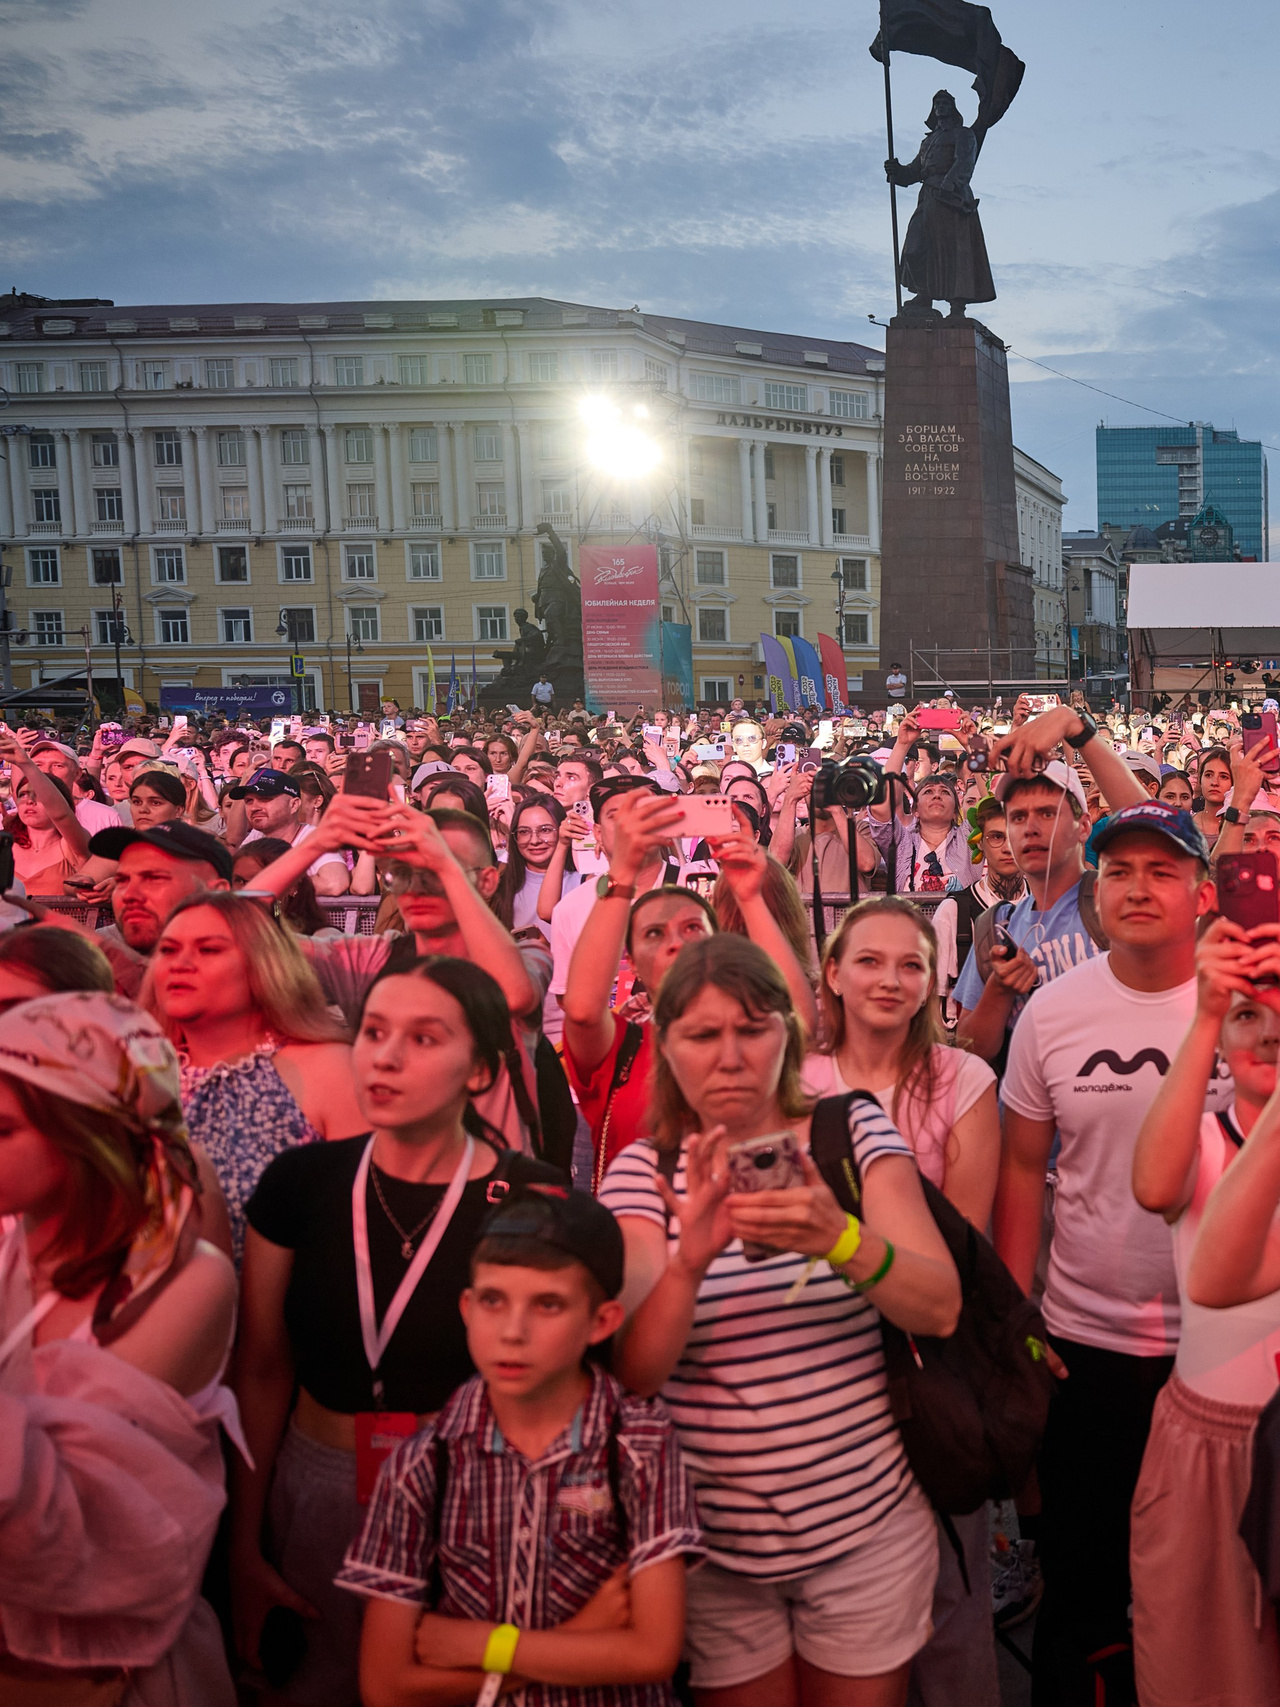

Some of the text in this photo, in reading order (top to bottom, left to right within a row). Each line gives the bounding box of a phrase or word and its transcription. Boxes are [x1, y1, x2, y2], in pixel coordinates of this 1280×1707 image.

[716, 414, 843, 437] ДАЛЬРЫБВТУЗ
[906, 425, 956, 434] БОРЦАМ
[898, 434, 964, 442] ЗА ВЛАСТЬ
[905, 444, 959, 452] СОВЕТОВ
[668, 682, 690, 697] ГОРОД
[1031, 932, 1100, 985] GINA
[1074, 1083, 1132, 1093] молодёжь
